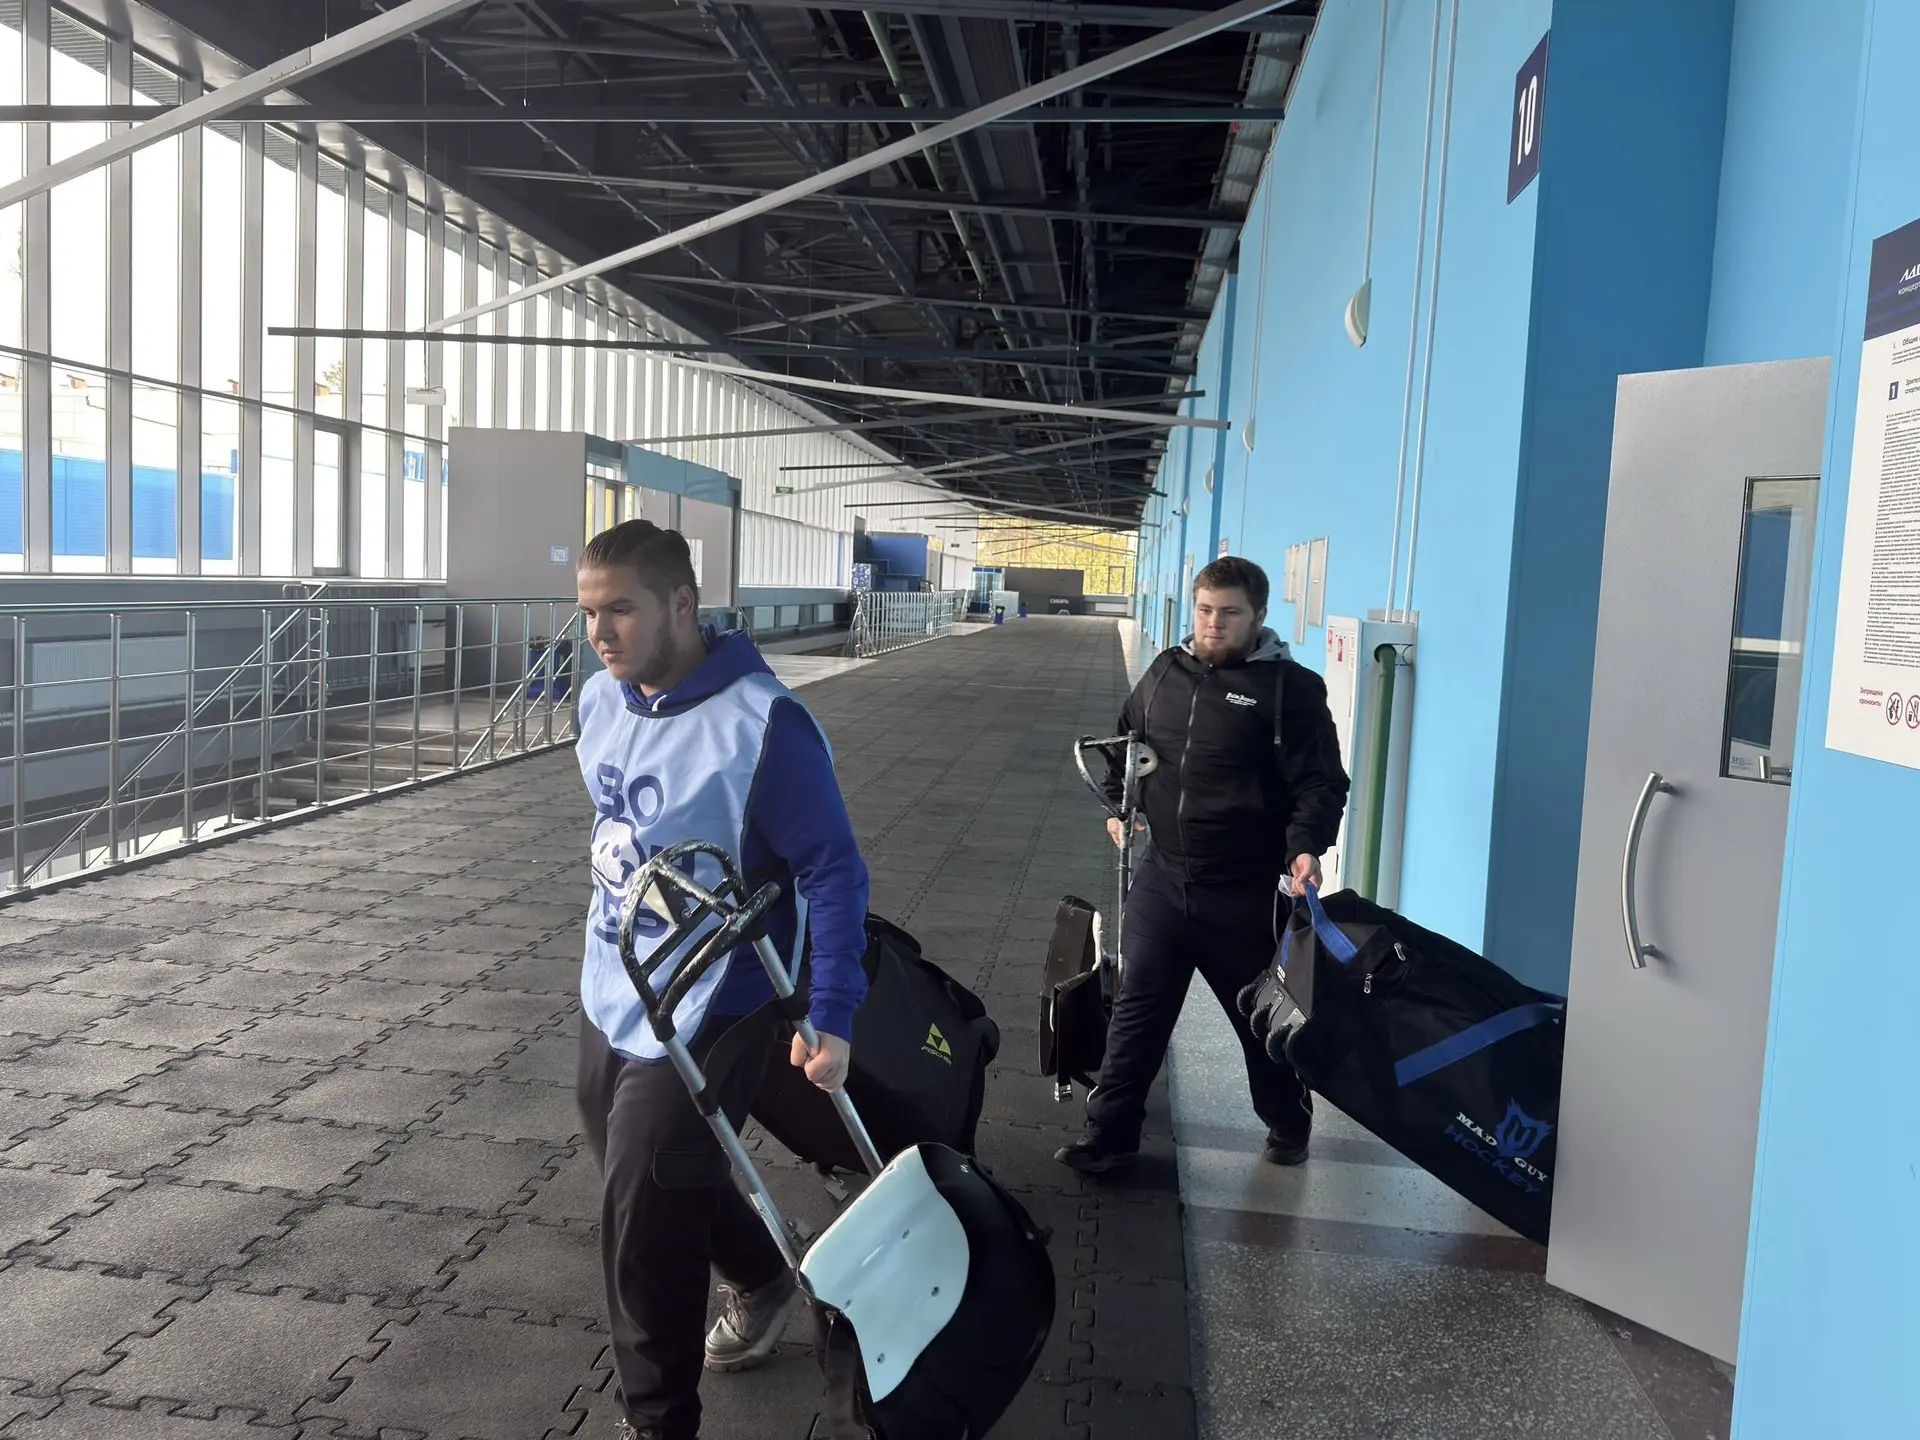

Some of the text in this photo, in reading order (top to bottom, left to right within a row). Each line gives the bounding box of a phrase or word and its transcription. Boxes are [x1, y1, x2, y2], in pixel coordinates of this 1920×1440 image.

[1517, 75, 1538, 166] 10
[1891, 385, 1896, 398] 1
[1443, 1123, 1540, 1194] HOCKEY
[1456, 1111, 1549, 1182] MAD GUY
